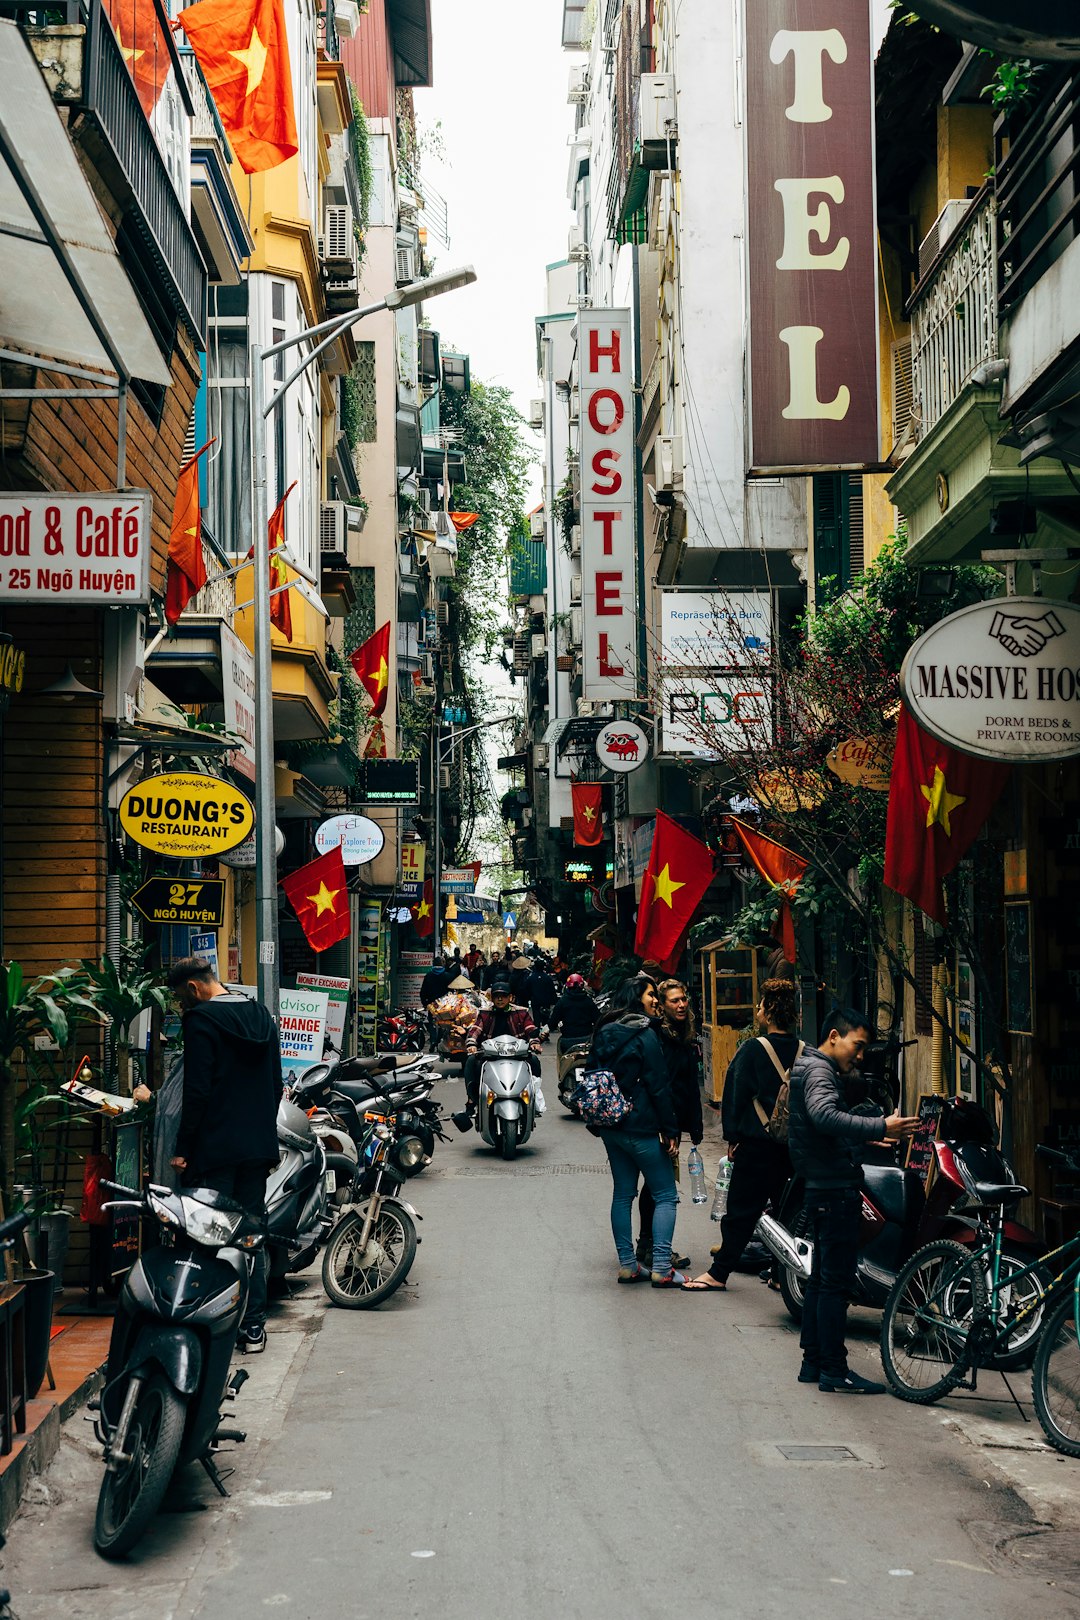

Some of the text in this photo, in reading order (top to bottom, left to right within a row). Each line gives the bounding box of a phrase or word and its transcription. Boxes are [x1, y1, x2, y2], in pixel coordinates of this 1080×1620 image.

[769, 28, 850, 420] TEL
[588, 329, 624, 676] HOSTEL
[44, 506, 64, 555] &
[76, 506, 139, 557] Café
[8, 568, 135, 595] 25 Ngõ Huyện
[917, 665, 1028, 700] MASSIVE
[670, 692, 763, 724] PDC
[986, 716, 1071, 728] DORM BEDS &
[977, 730, 1031, 740] PRIVATE
[128, 796, 245, 824] DUONG'S
[141, 822, 229, 838] RESTAURANT
[317, 833, 338, 845] Hanoi
[340, 833, 365, 847] Explore
[169, 883, 204, 906] 27
[154, 907, 216, 922] NGÕ HUYỆN
[297, 975, 348, 990] MONEY EXCHANGE
[280, 997, 320, 1013] dvisor
[174, 1259, 202, 1270] HONDA
